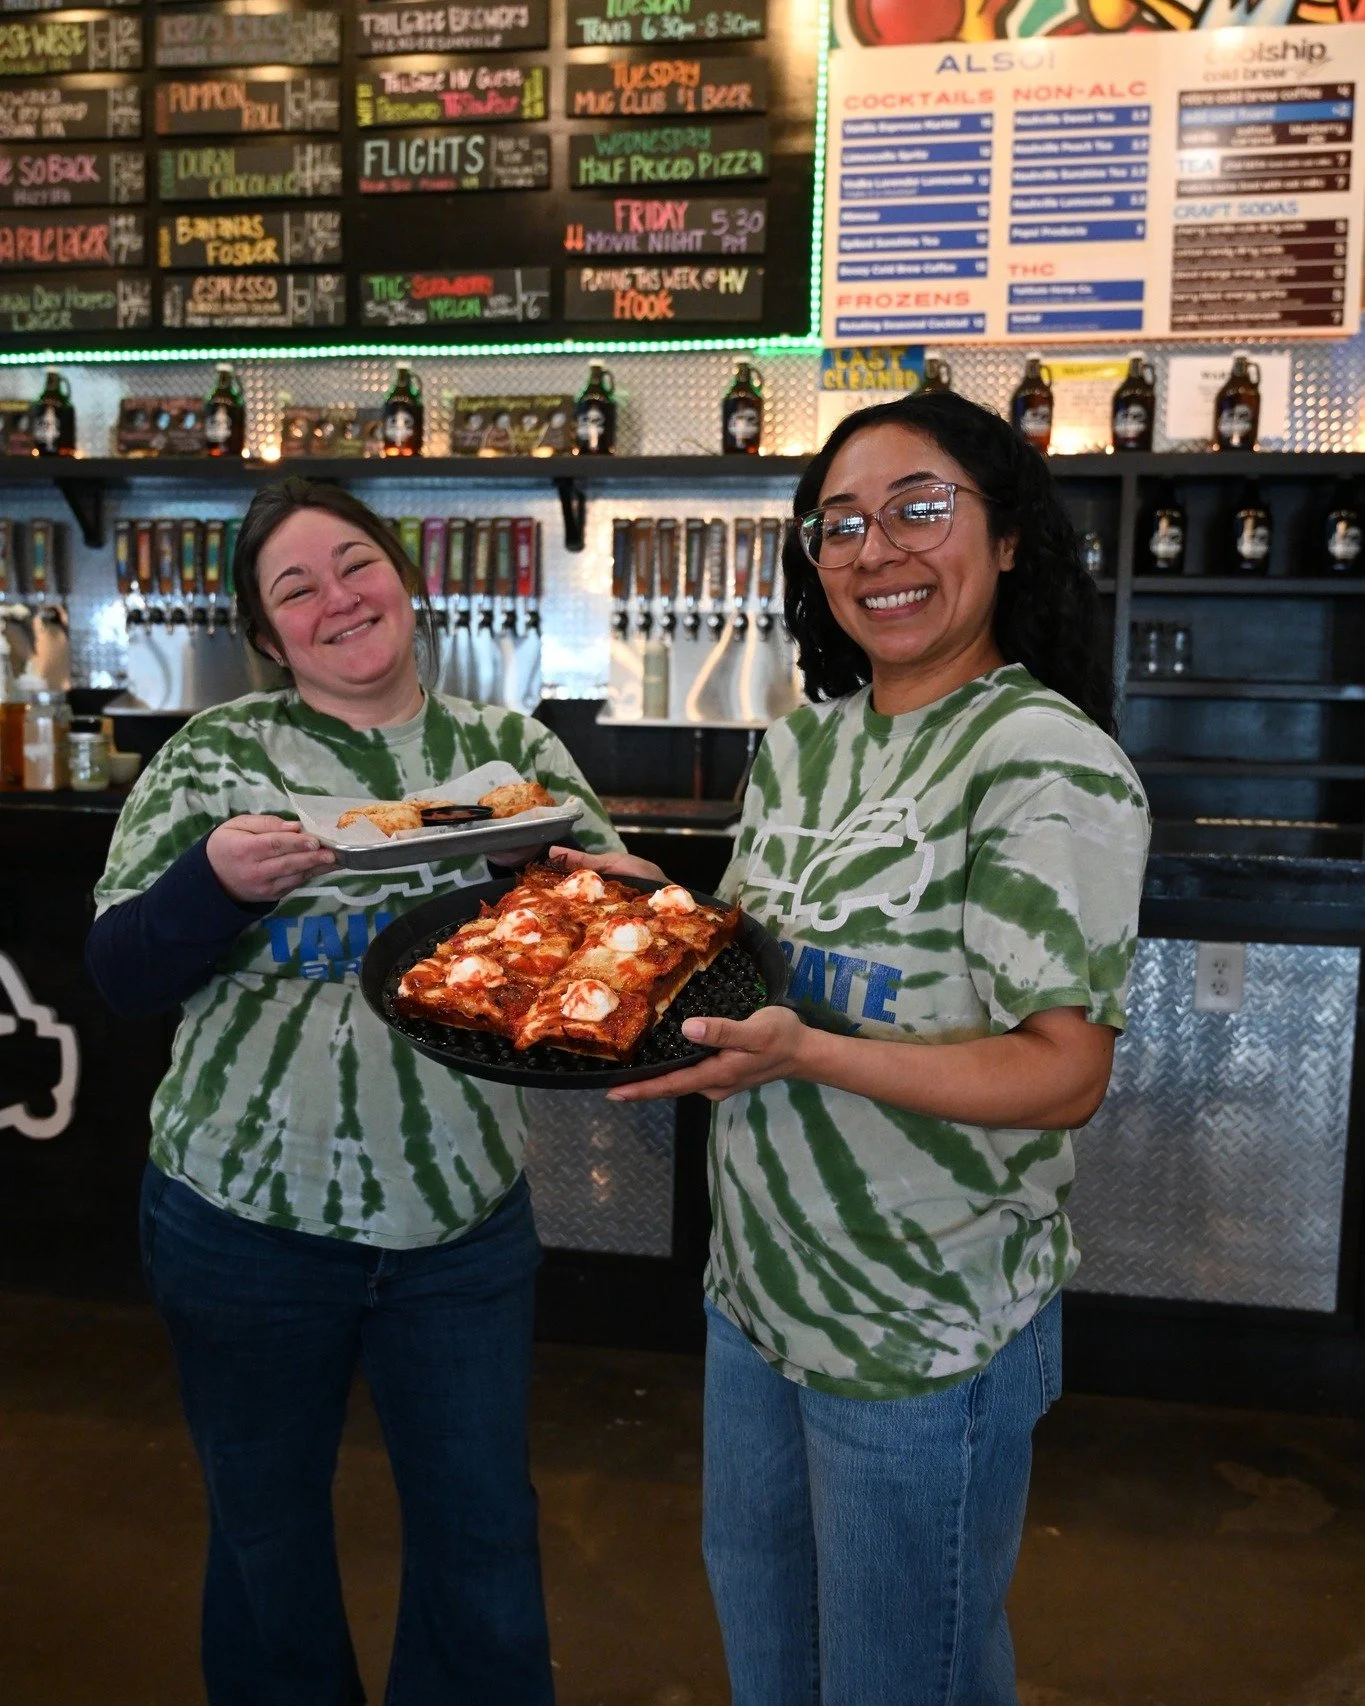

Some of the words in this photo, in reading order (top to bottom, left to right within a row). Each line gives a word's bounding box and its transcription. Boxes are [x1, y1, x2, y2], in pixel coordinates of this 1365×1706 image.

[1204, 37, 1327, 64] colship
[573, 90, 616, 115] MUG
[620, 90, 667, 115] CLUB
[702, 82, 752, 111] BEER
[844, 88, 996, 111] COCKTAILS
[1013, 80, 1149, 102] NON-ALC
[241, 102, 283, 131] ROLL
[363, 134, 485, 178] FLIGHTS
[578, 155, 626, 186] HALF
[630, 153, 695, 184] PRICED
[698, 149, 764, 178] PIZZA
[613, 199, 690, 234] FRIDAY
[1174, 203, 1231, 219] CRAFT
[1239, 201, 1298, 216] SODAS
[585, 231, 641, 254] MOVIE
[648, 228, 706, 253] NIGHT
[1007, 264, 1055, 277] THC
[613, 286, 675, 321] HOOK
[836, 292, 971, 309] FROZENS
[833, 349, 904, 371] LAST
[823, 369, 920, 391] CLEANED
